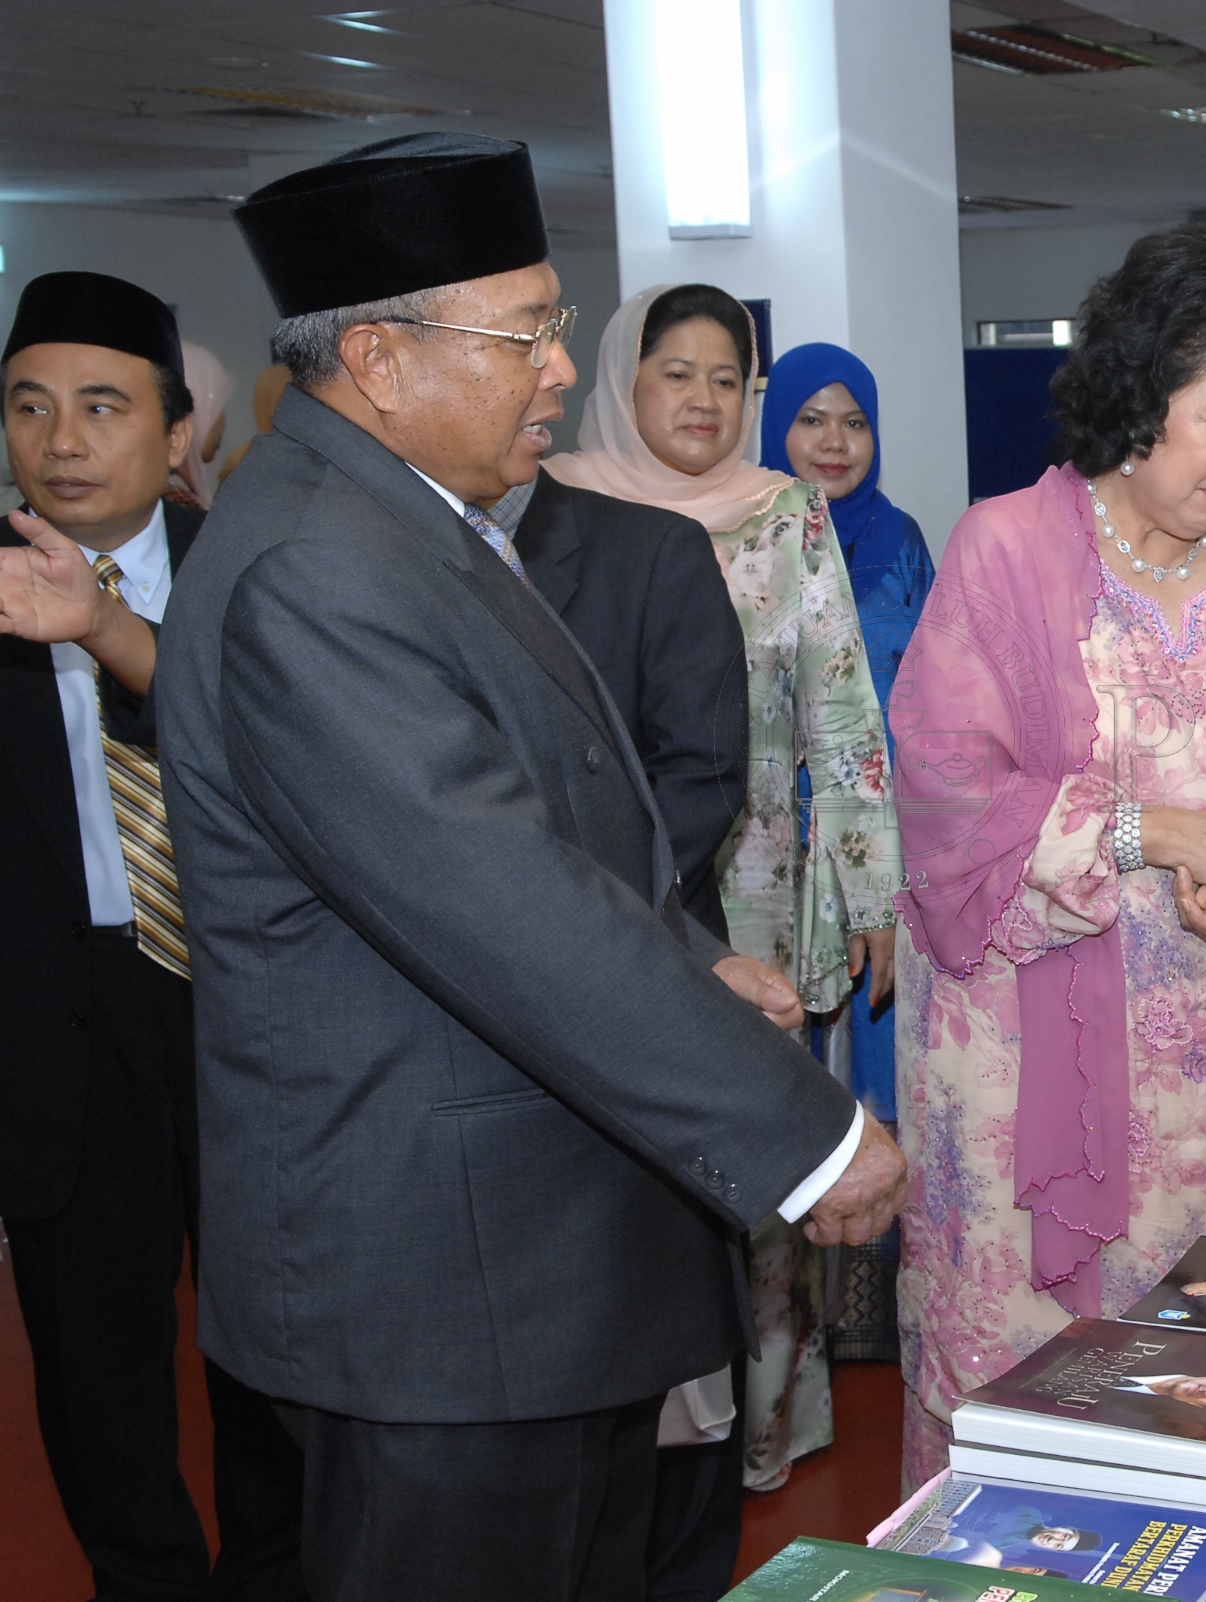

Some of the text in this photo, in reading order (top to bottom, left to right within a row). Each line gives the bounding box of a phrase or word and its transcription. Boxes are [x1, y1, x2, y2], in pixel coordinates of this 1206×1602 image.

[1035, 1347, 1104, 1393] GEMILANG
[1056, 1340, 1167, 1411] PENERAJU
[1120, 1521, 1167, 1567] BERTARAF
[1122, 1523, 1188, 1592] PERKHIDMATAN
[809, 1569, 850, 1601] MOKHTAR
[1143, 1571, 1179, 1597] PER
